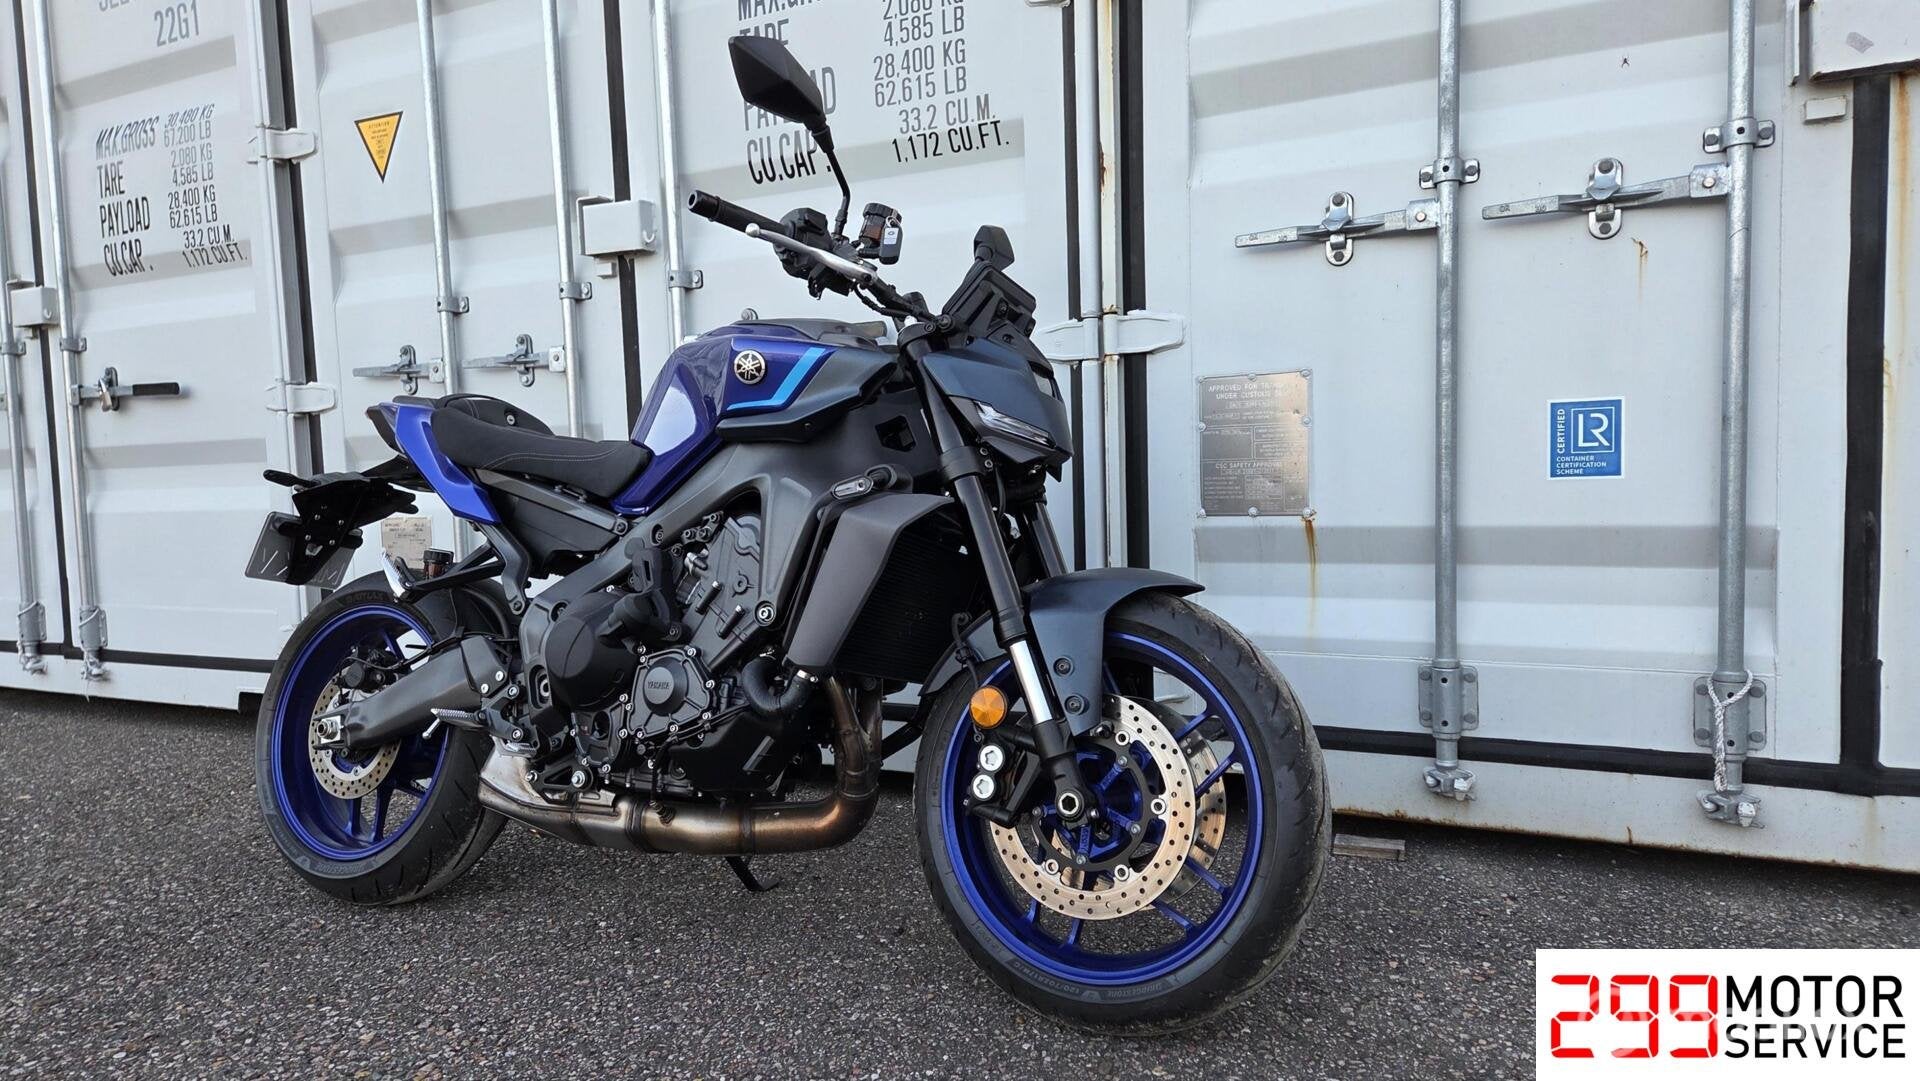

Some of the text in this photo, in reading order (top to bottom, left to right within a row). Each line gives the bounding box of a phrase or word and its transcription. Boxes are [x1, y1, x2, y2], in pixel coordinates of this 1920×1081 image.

[154, 0, 200, 47] 22G1
[884, 6, 965, 47] 4,585 LB
[873, 39, 966, 81] 28,400 KG
[874, 72, 936, 108] 62,615
[944, 66, 967, 95] LB
[199, 120, 211, 140] LB
[899, 94, 995, 134] 33.2 CU.M.
[96, 116, 160, 160] MAX.GROSS
[892, 120, 1010, 163] 1,172 CU.FT.
[97, 161, 125, 199] TARE
[200, 142, 213, 161] KG
[201, 161, 214, 181] LB
[100, 197, 150, 238] PAYLOAD
[203, 184, 216, 203] KG
[204, 203, 218, 223] LB
[183, 228, 205, 249] 33.2
[1557, 408, 1565, 454] CERTIFIED
[1578, 413, 1610, 447] LR
